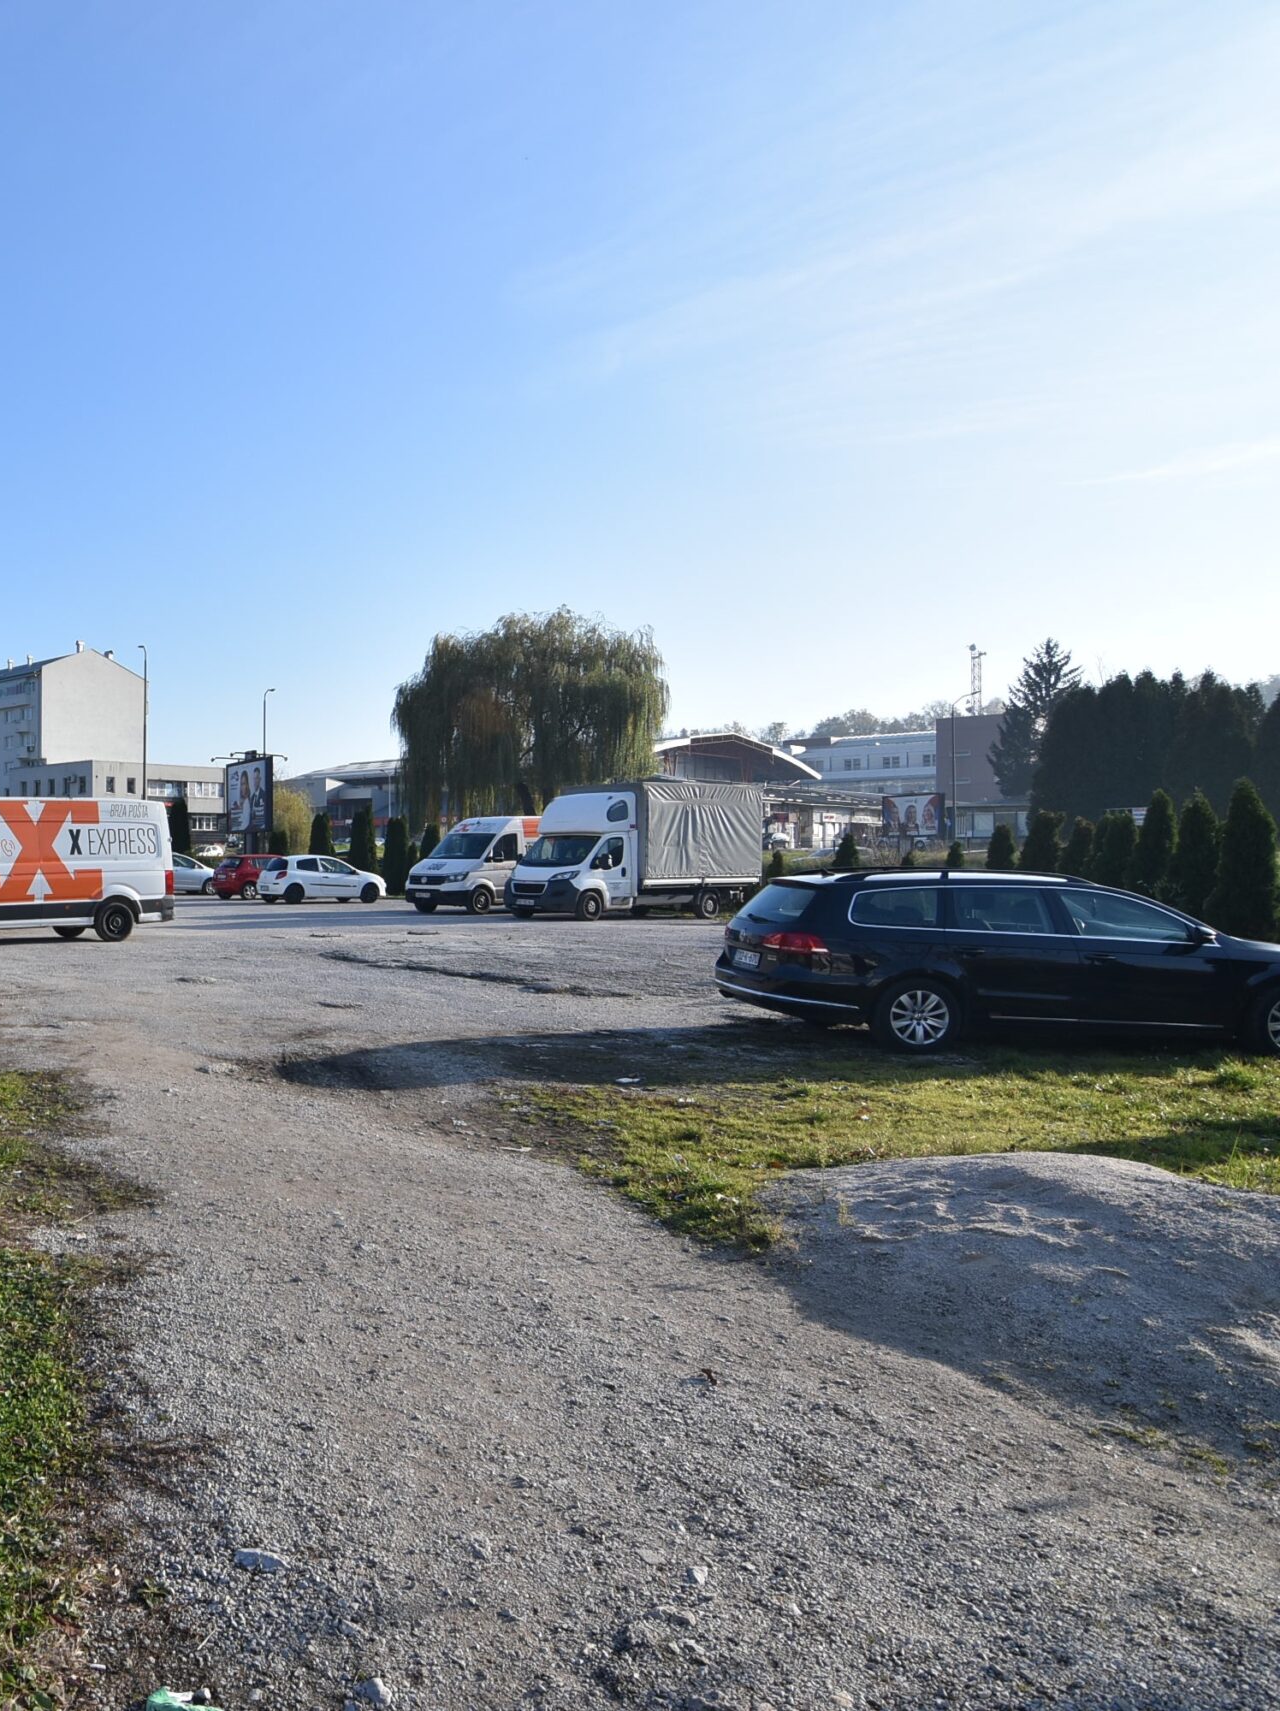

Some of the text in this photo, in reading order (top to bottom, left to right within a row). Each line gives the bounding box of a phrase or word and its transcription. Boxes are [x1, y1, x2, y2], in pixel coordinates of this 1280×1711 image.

[110, 802, 149, 818] BRZA POŠTA
[68, 828, 157, 855] X EXPRESS
